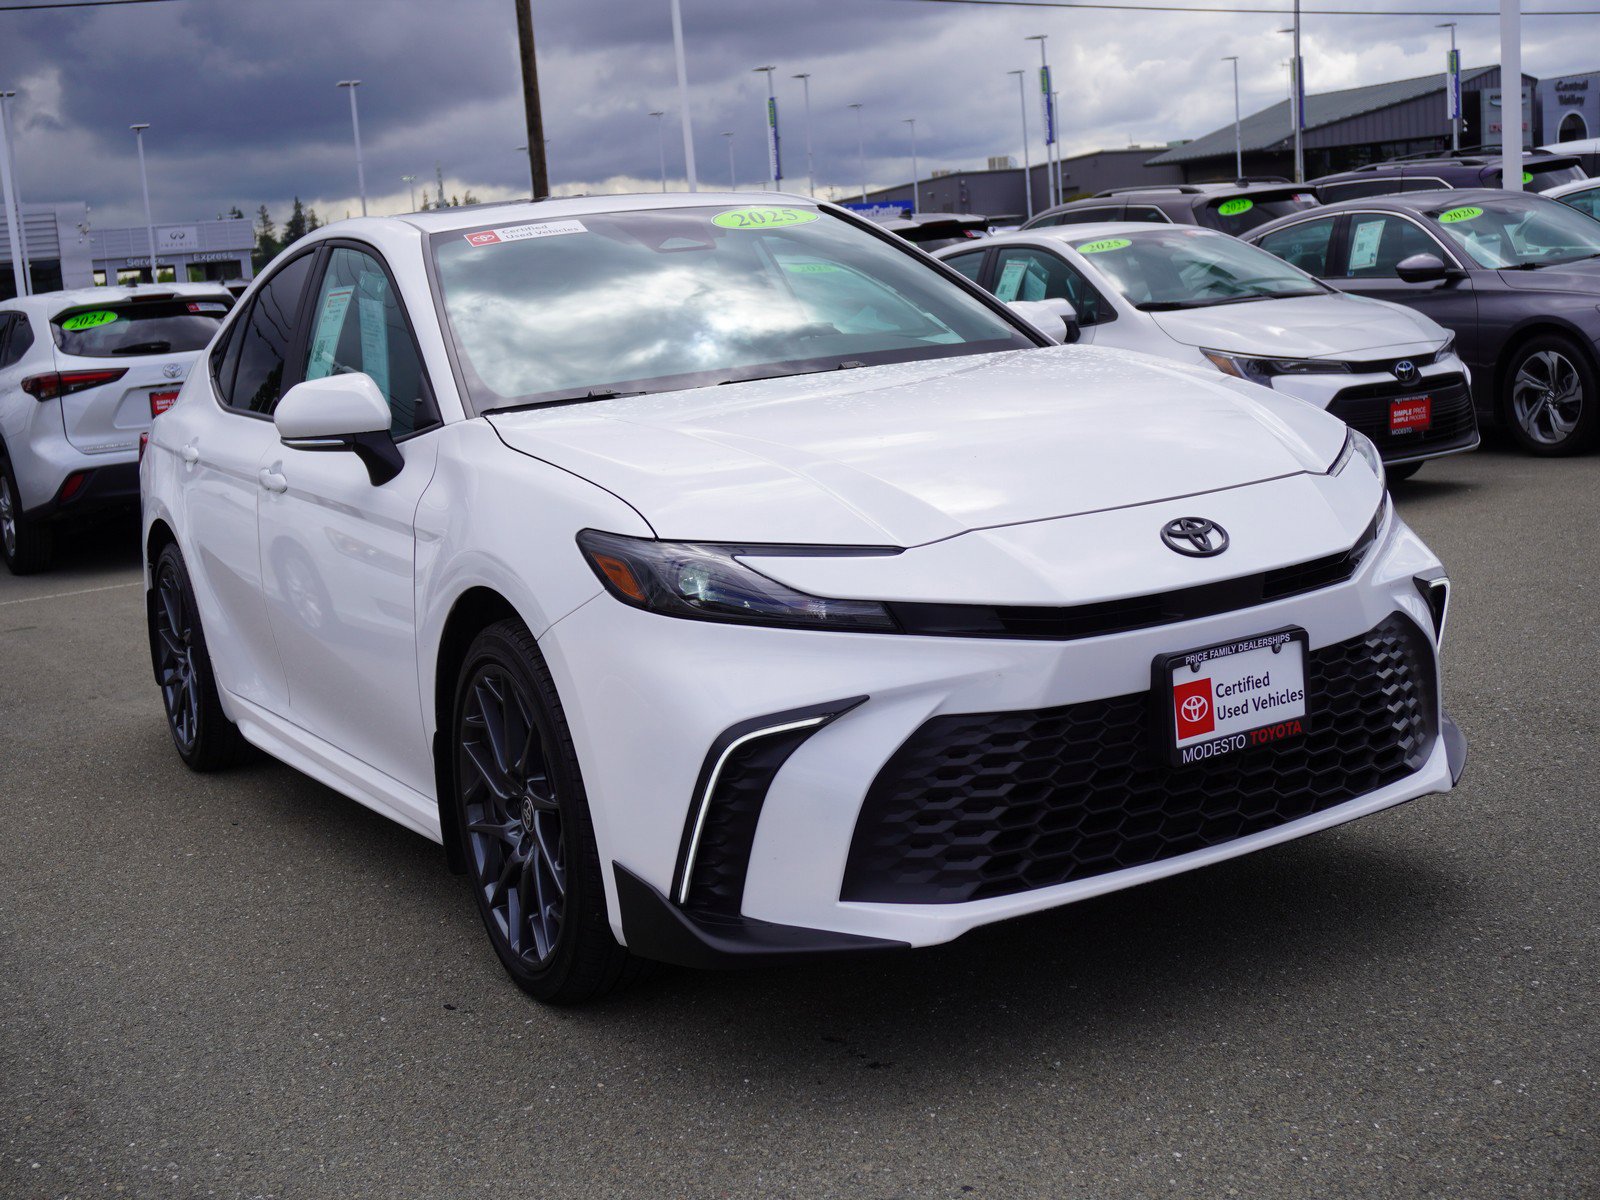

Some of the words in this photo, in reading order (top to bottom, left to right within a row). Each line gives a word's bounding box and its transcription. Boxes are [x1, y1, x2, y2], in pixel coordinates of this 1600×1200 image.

[731, 209, 798, 226] 2025
[1447, 208, 1475, 221] 2020
[502, 224, 549, 234] Certified
[505, 231, 533, 239] Used
[535, 227, 579, 236] Vehicles
[1088, 240, 1121, 251] 2025
[126, 257, 165, 267] Servce
[193, 252, 233, 262] Express
[71, 311, 106, 328] 2024
[1394, 409, 1412, 417] SIMPLE
[1413, 407, 1425, 415] PRICE
[1392, 427, 1412, 435] MODESTO
[1185, 651, 1208, 665] PRICE
[1209, 644, 1237, 659] FAMILY
[1238, 633, 1291, 652] DEALERSHIPS
[1215, 671, 1271, 698] Certified
[1217, 699, 1249, 720] Used
[1252, 688, 1304, 712] Vehicles
[1182, 734, 1246, 764] MODESTO
[1250, 720, 1302, 745] TOYOTA
